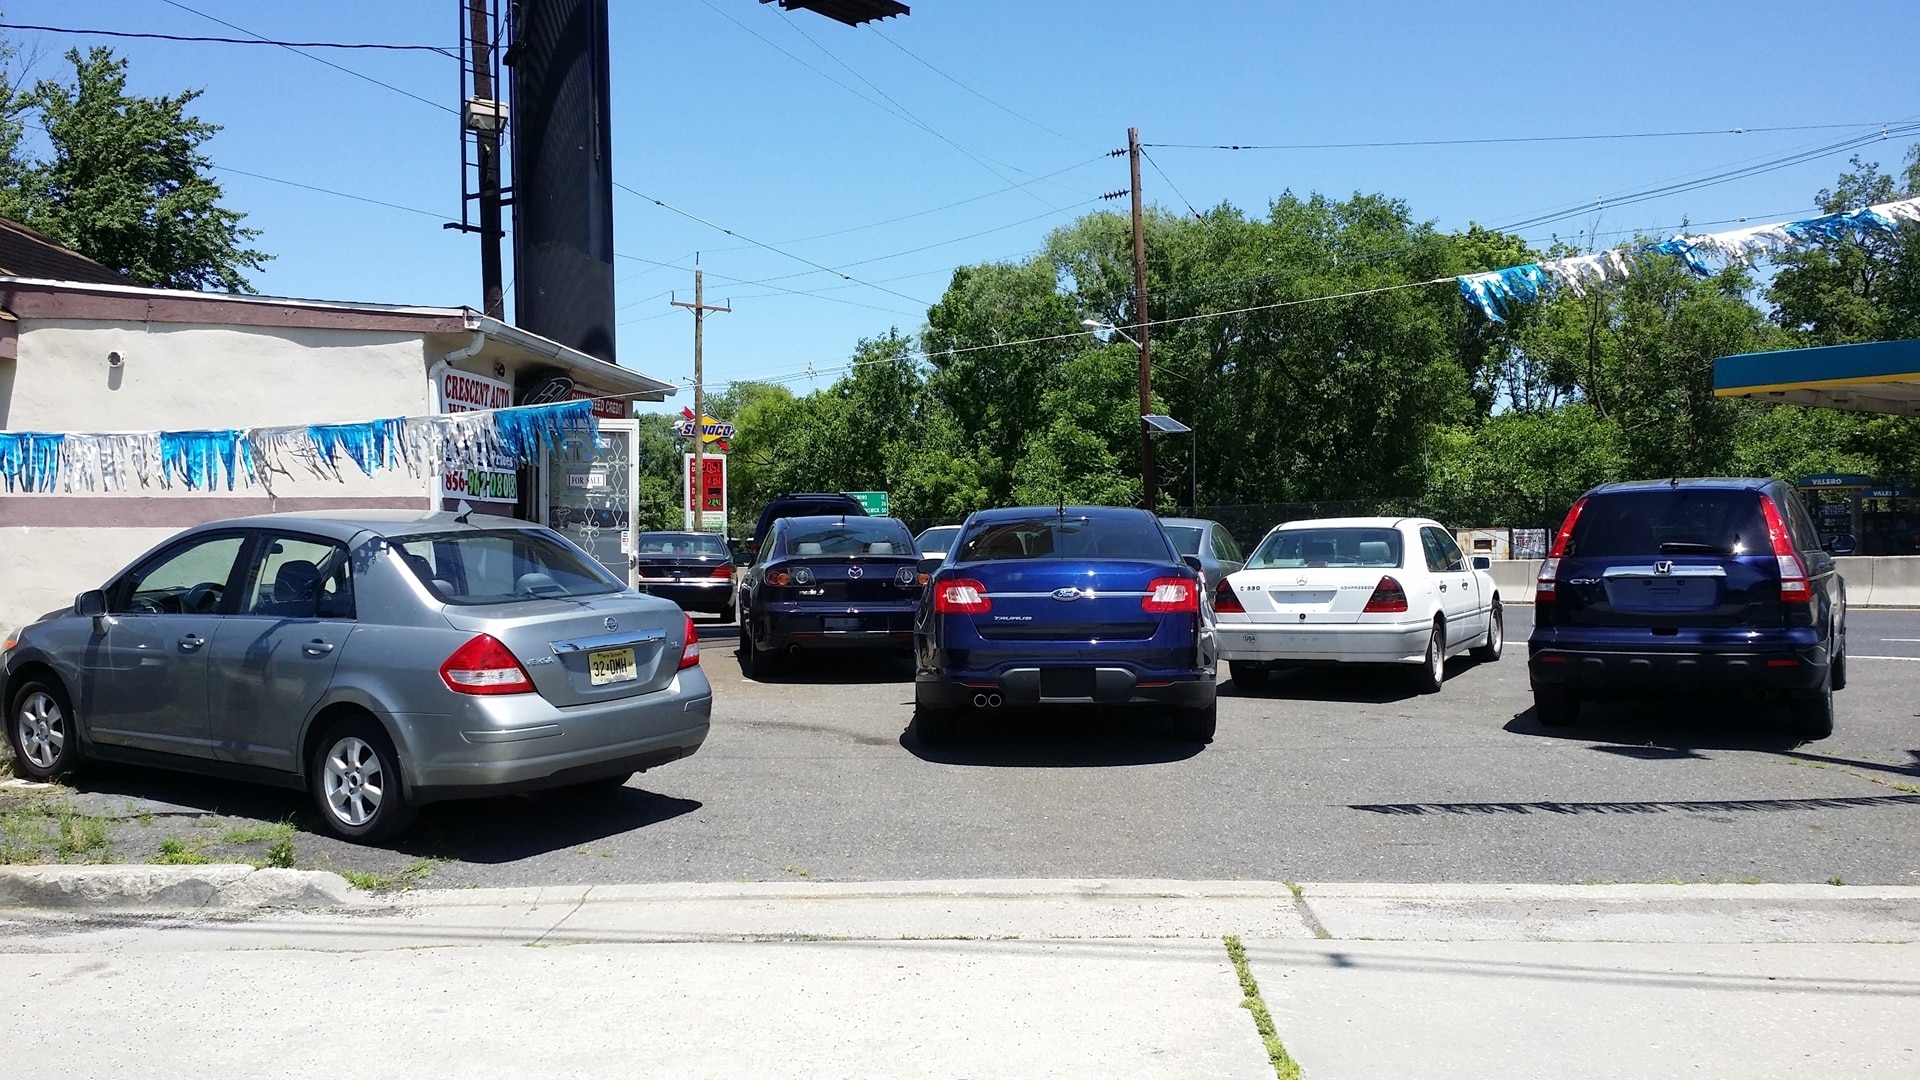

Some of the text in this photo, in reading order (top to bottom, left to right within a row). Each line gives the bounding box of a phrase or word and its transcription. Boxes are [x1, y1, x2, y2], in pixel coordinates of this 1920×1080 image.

[445, 374, 510, 408] CRESCENT AUTO
[605, 400, 623, 415] CREDIT
[571, 476, 602, 484] FOR SALE
